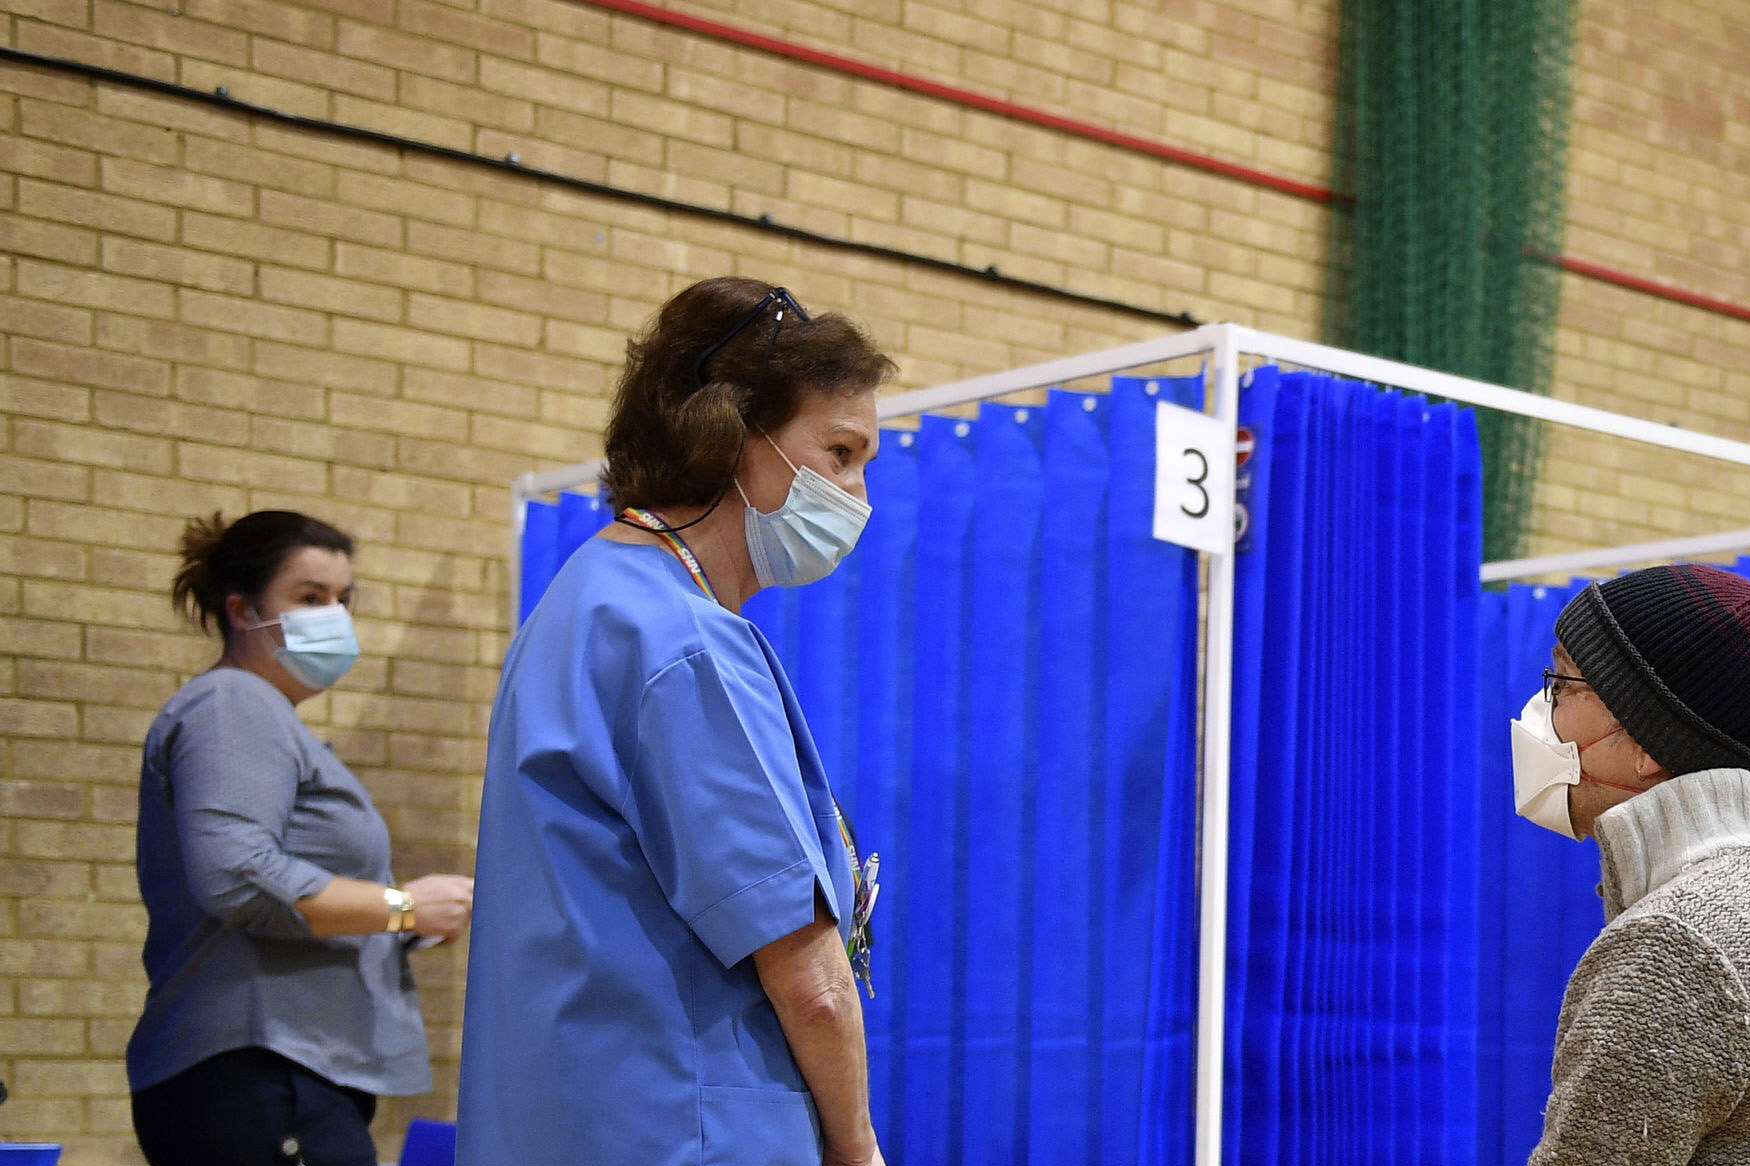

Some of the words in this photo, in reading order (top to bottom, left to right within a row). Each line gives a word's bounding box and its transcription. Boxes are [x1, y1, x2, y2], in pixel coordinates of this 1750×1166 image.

[1180, 448, 1209, 519] 3
[677, 547, 701, 573] NHS
[847, 845, 861, 871] NHS
